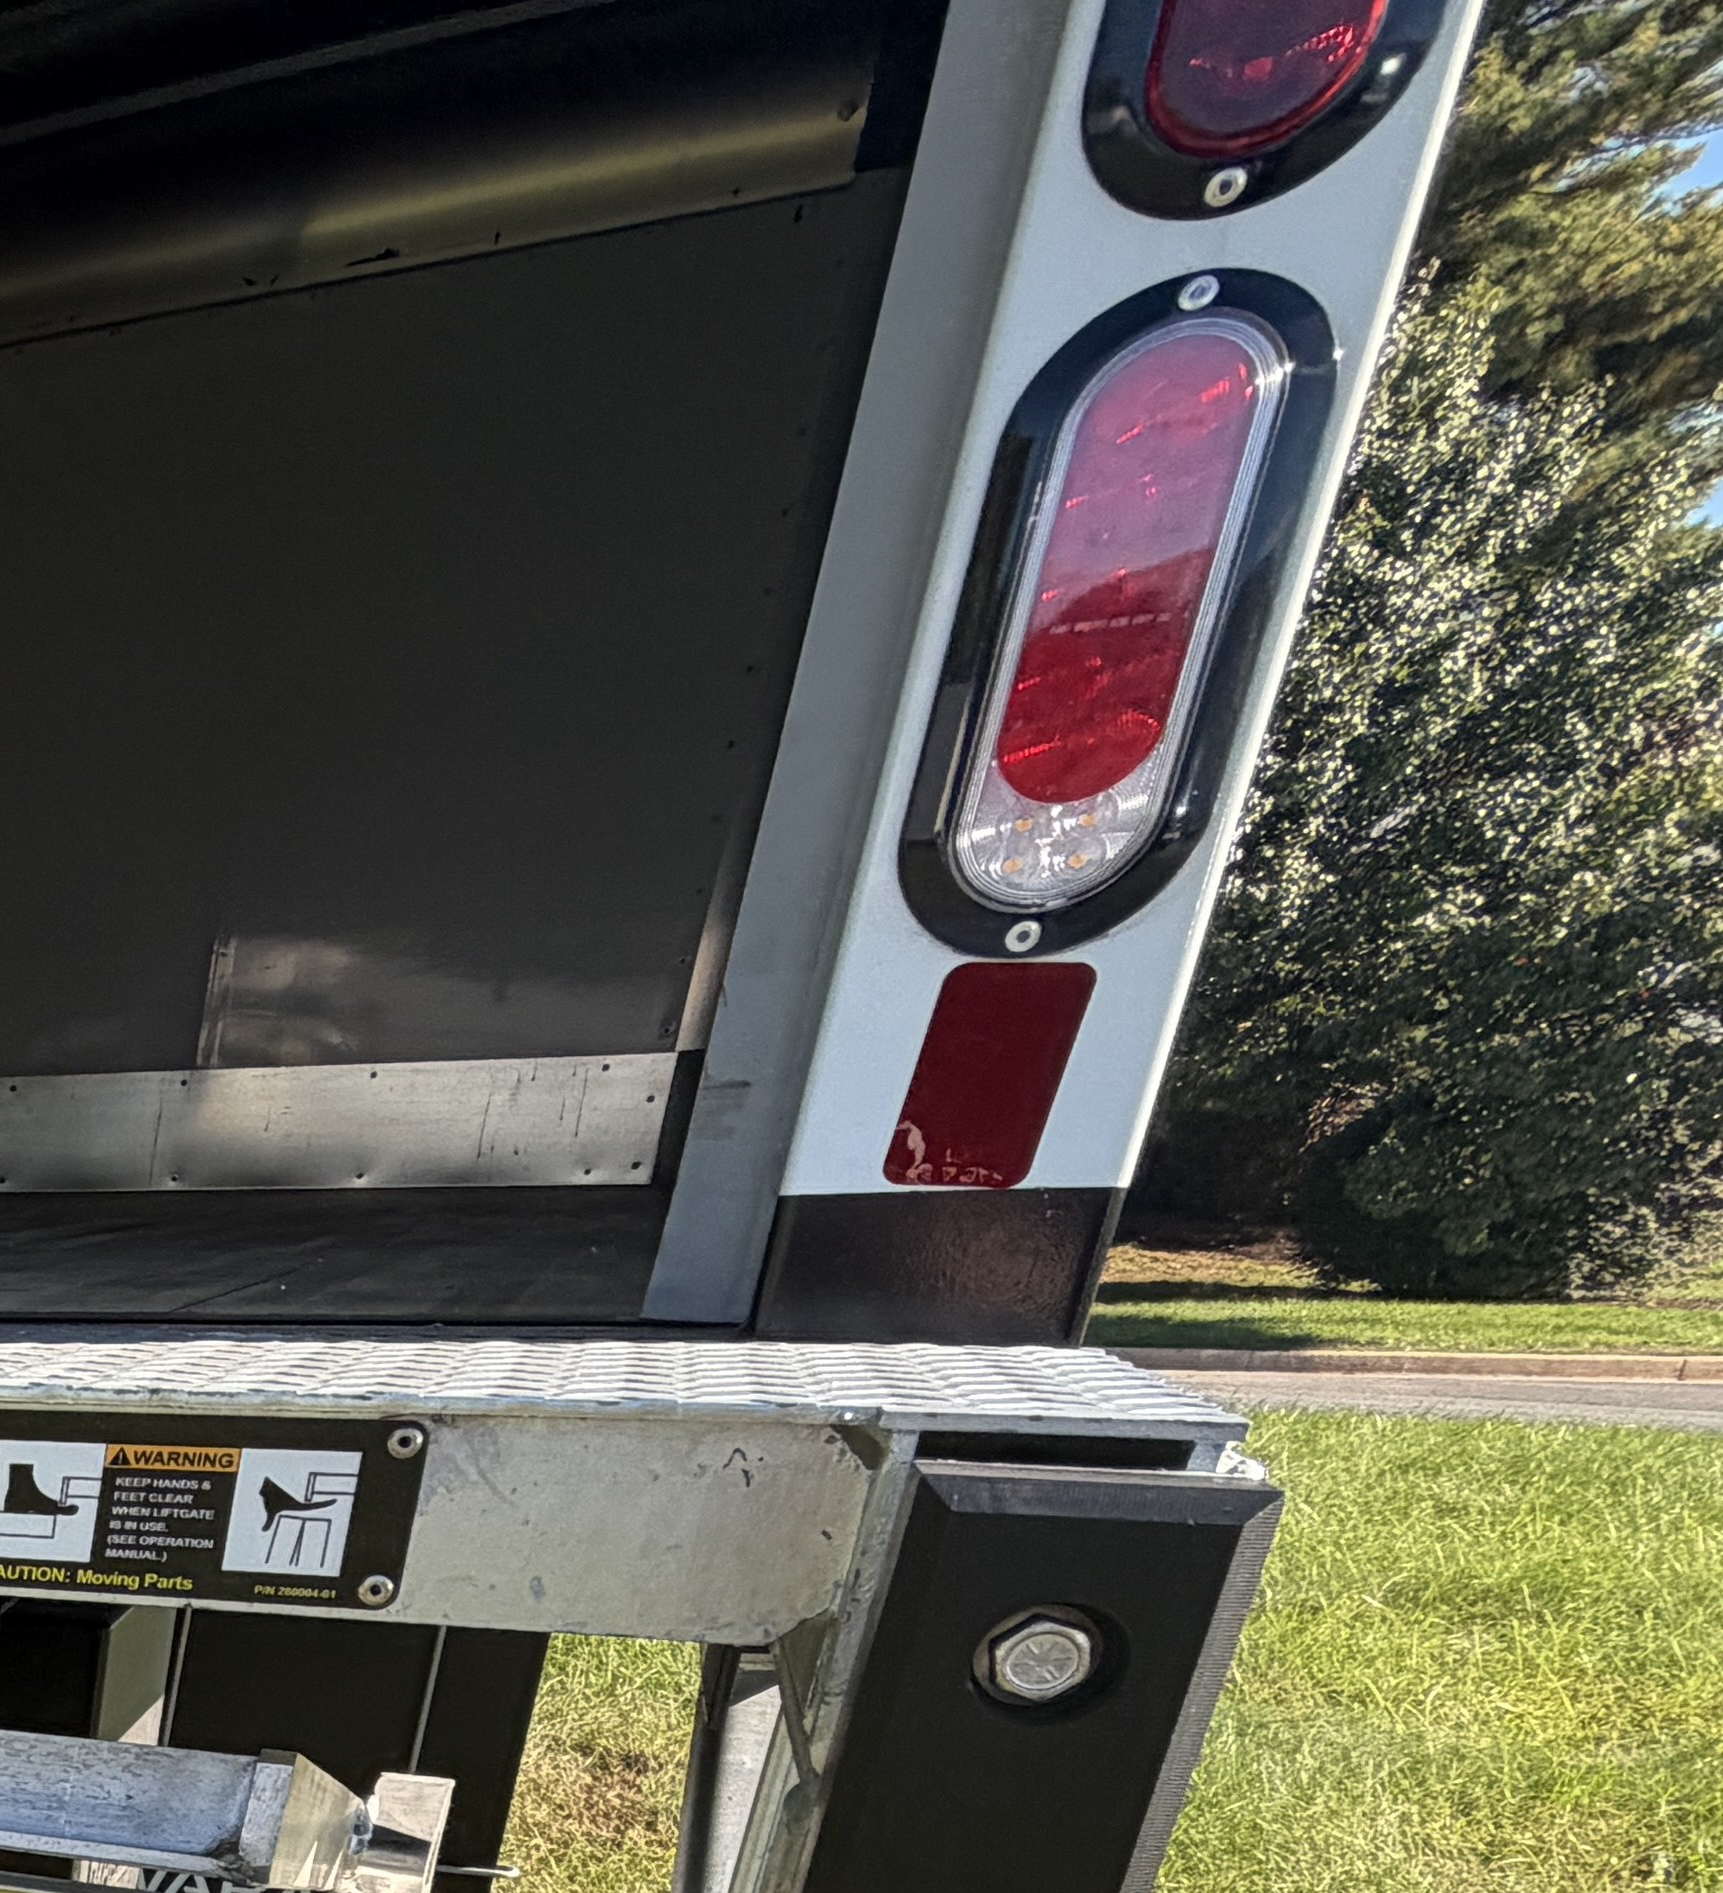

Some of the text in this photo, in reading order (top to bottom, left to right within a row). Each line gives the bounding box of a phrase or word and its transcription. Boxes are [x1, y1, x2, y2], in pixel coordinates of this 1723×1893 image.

[133, 1450, 235, 1469] WARNING
[115, 1477, 212, 1491] KEEP HANDS &
[113, 1491, 195, 1504] FEET CLEAR
[111, 1505, 215, 1520] WHEN LIFTGATE
[108, 1520, 169, 1532] IS IN USE.
[106, 1534, 214, 1549] (SEE OPERATION
[104, 1548, 168, 1563] MANUAL.)
[76, 1569, 140, 1590] Moving
[144, 1573, 194, 1591] Parts
[254, 1584, 276, 1596] P/N
